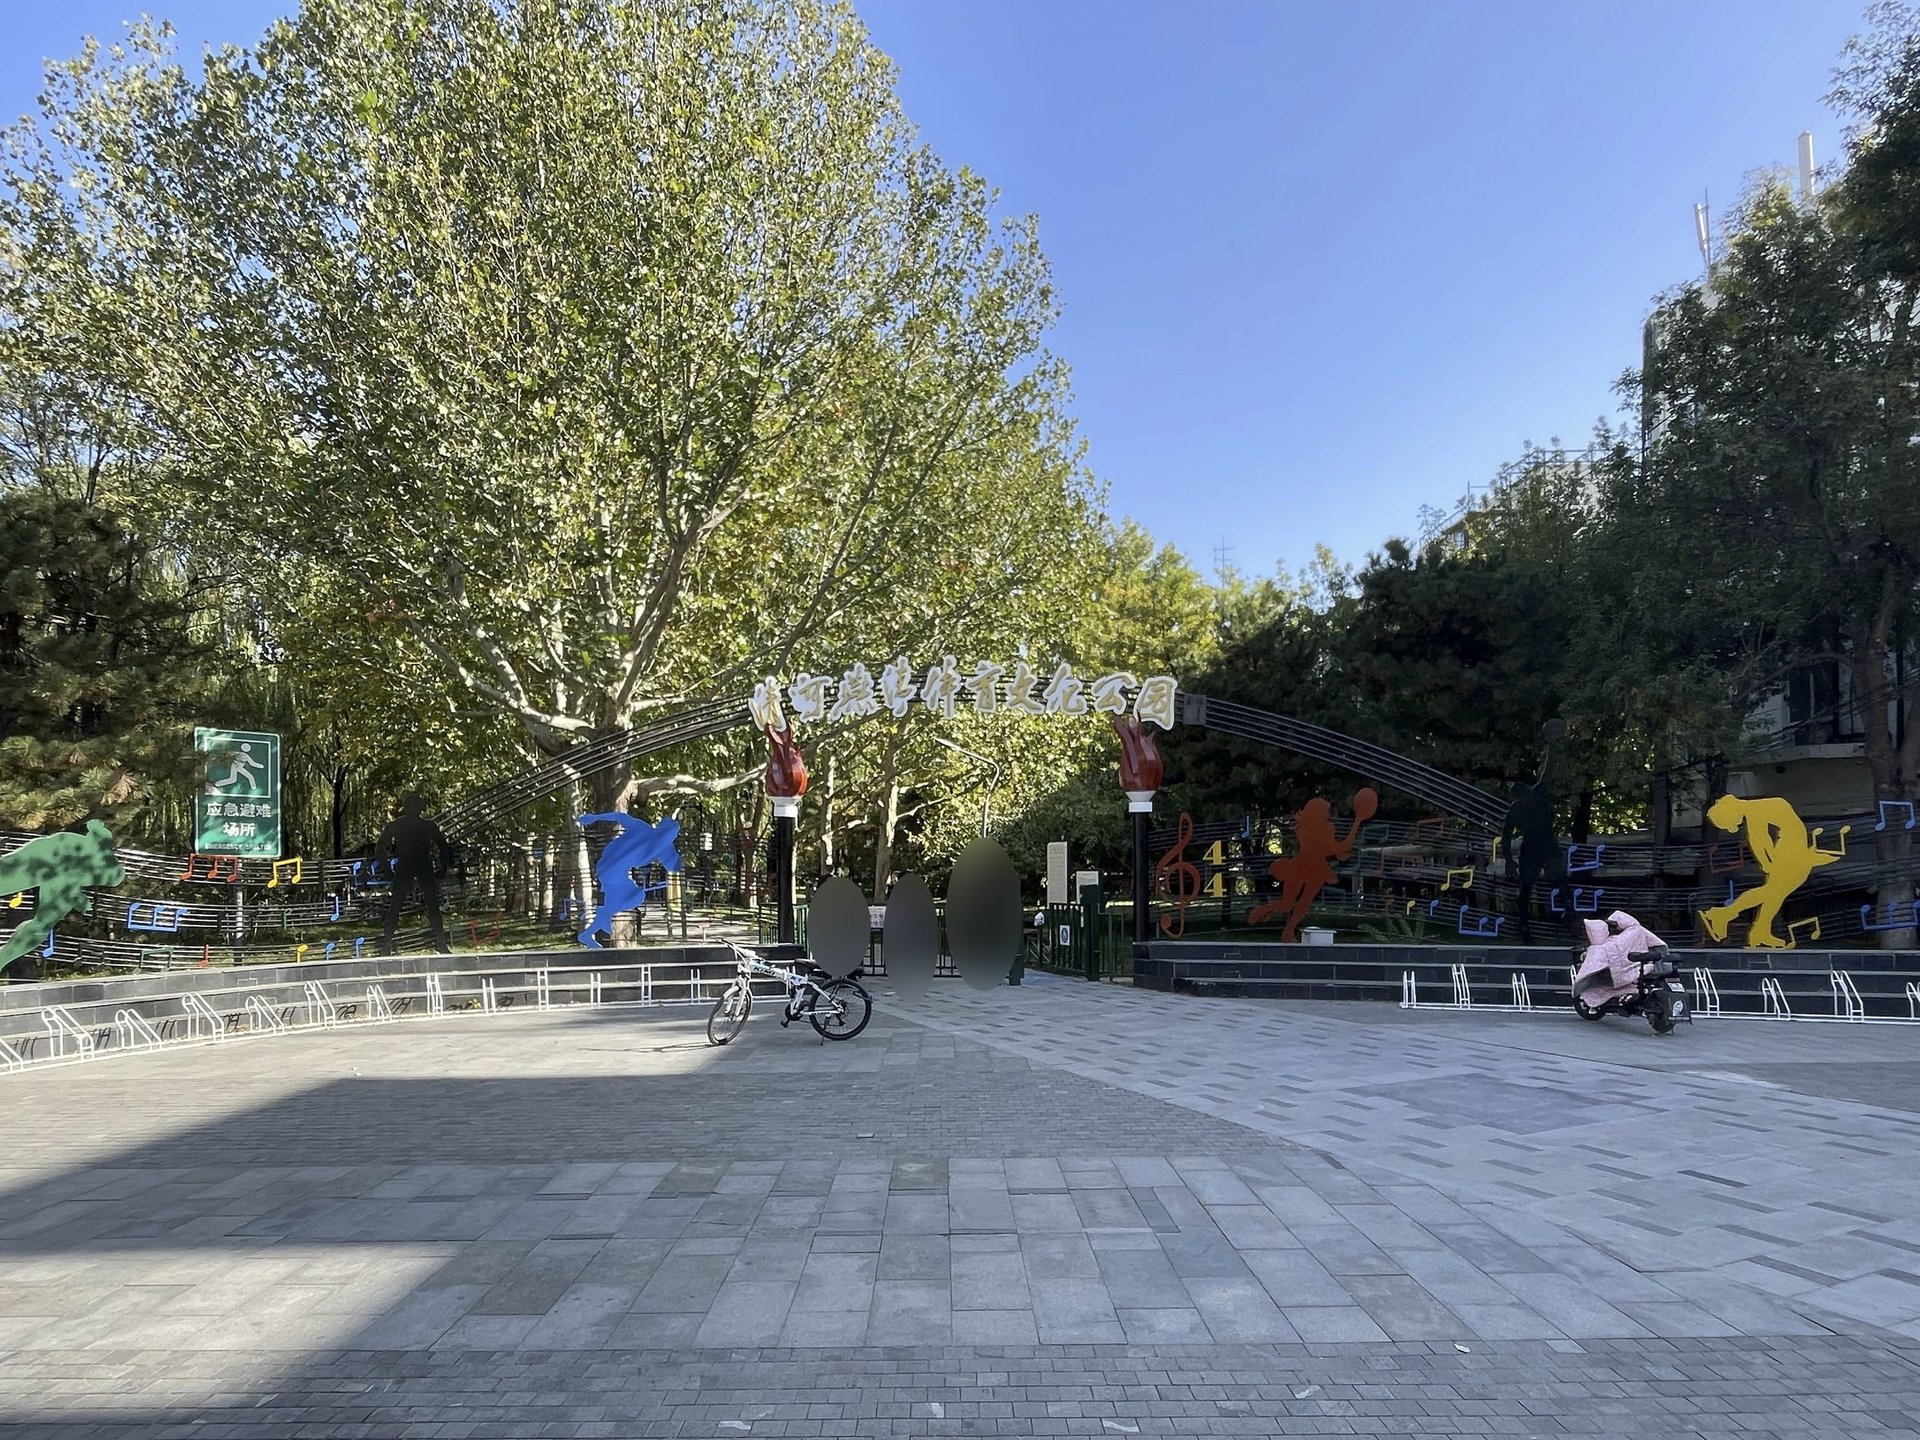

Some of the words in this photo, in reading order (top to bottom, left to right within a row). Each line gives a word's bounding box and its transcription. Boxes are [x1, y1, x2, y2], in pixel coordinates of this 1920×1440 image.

[207, 803, 271, 817] 应急避难
[223, 822, 256, 836] 场所
